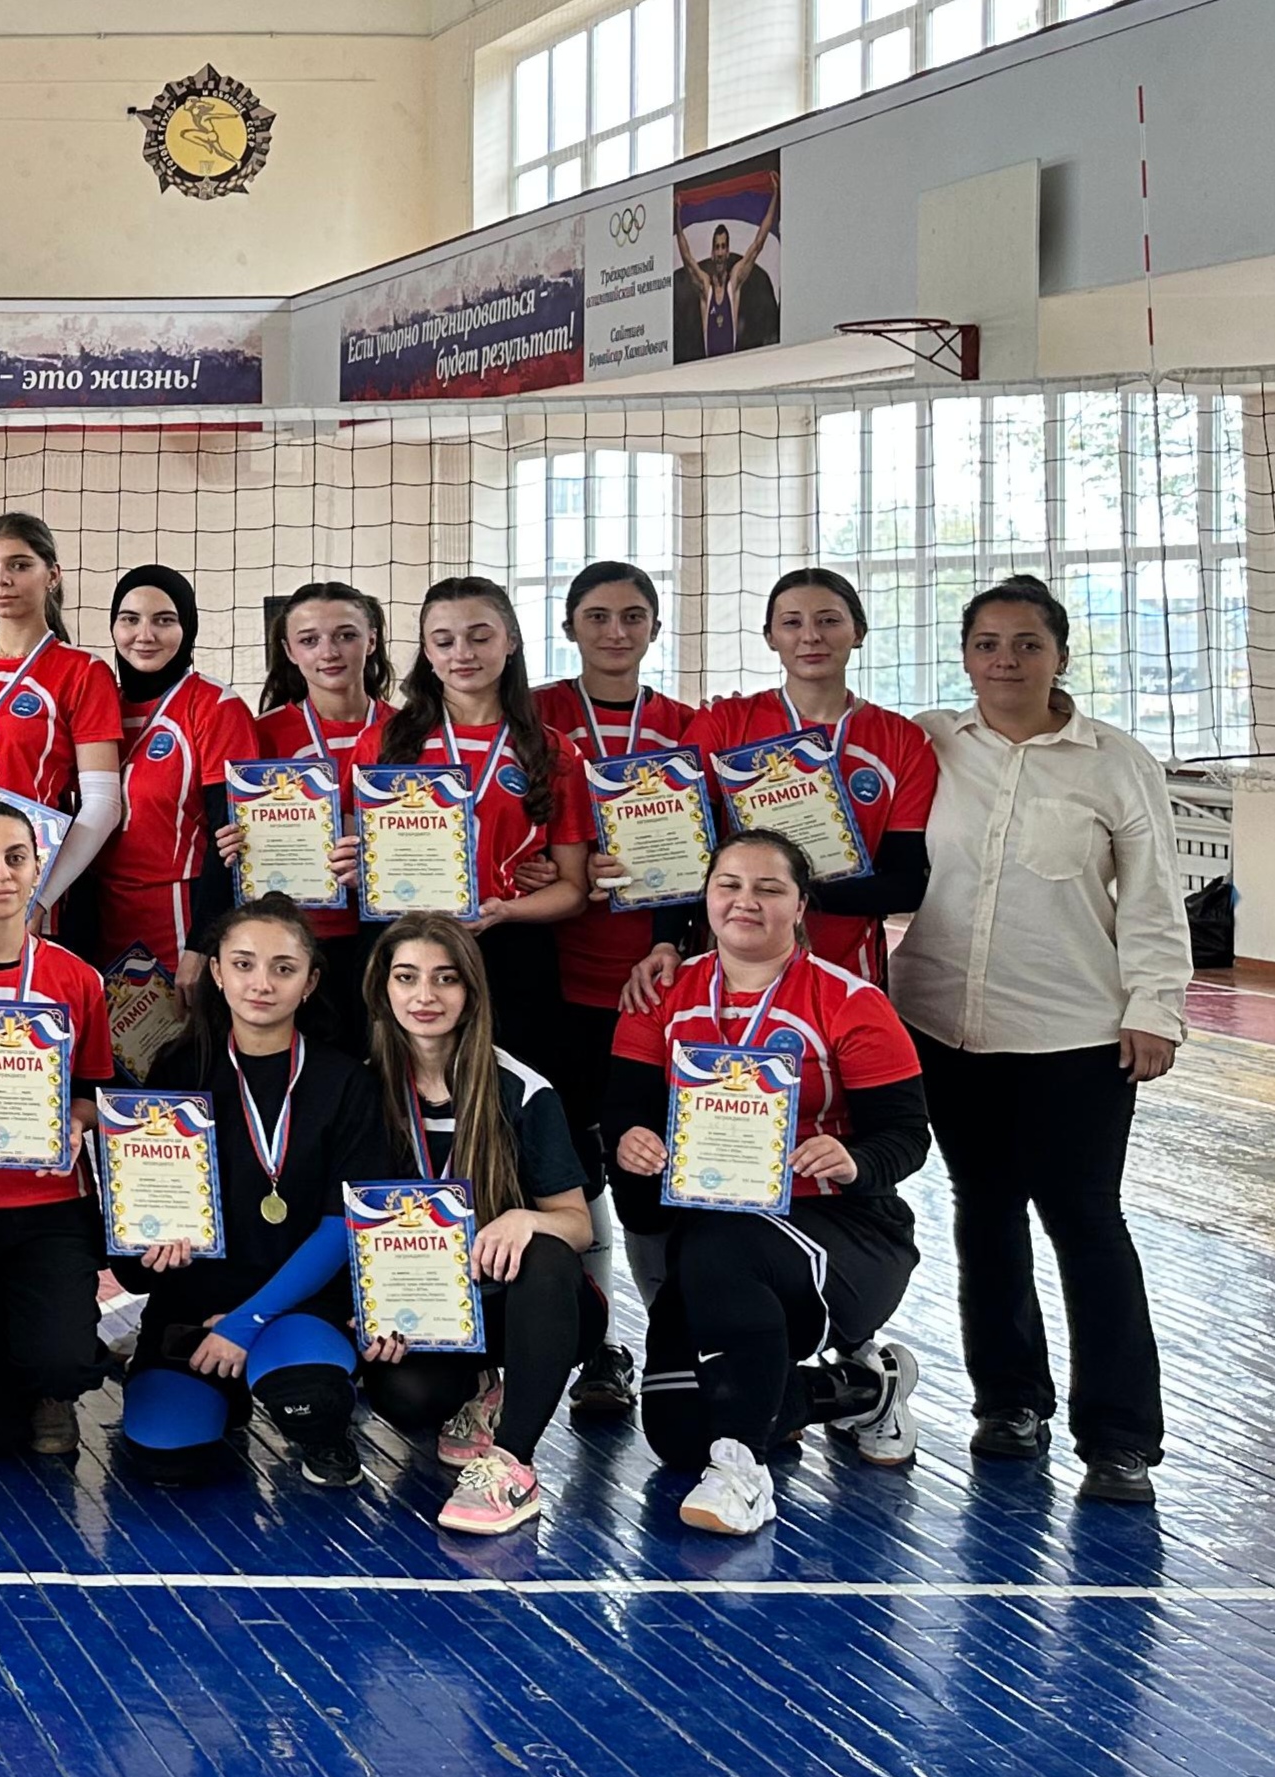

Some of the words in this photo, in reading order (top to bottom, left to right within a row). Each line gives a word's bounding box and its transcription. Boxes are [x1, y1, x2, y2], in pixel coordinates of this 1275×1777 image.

[347, 335, 375, 364] Если
[375, 324, 420, 365] упорно
[421, 288, 536, 350] тренироваться
[436, 344, 479, 388] будет
[480, 311, 575, 379] результат!
[22, 368, 84, 391] это
[90, 360, 201, 391] жизнь!
[749, 781, 819, 809] ГРАМОТА
[251, 808, 316, 822] ГРАМОТА
[617, 799, 684, 820] ГРАМОТА
[379, 815, 448, 830] ГРАМОТА
[111, 990, 160, 1038] ГРАМОТА
[695, 1096, 769, 1116] ГРАМОТА
[123, 1143, 191, 1160] ГРАМОТА
[374, 1236, 448, 1251] ГРАМОТА
